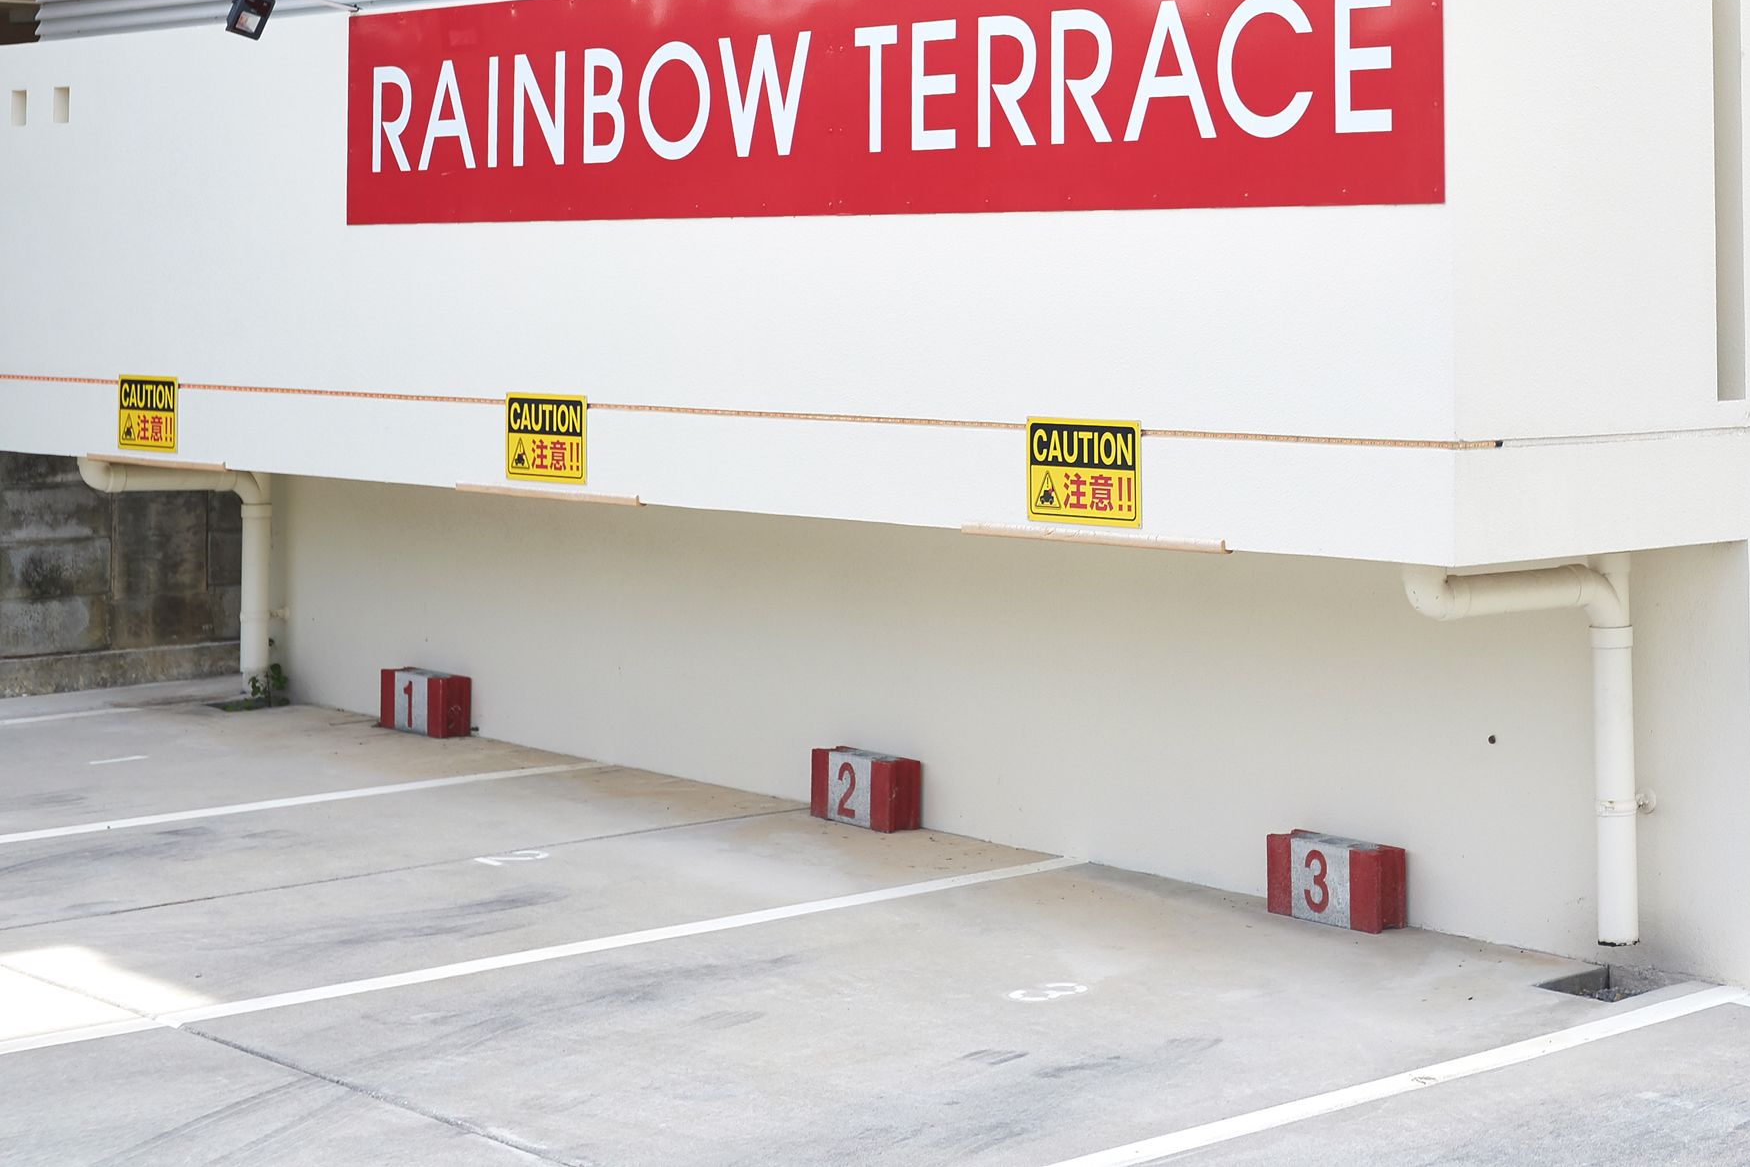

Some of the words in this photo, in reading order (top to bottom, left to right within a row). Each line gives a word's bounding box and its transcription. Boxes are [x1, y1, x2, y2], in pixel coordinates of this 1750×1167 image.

[371, 30, 812, 174] RAINBOW
[121, 382, 174, 409] CAUTION
[136, 414, 173, 443] 注意!!
[509, 401, 581, 434] CAUTION
[531, 438, 580, 472] 注意!!
[1032, 428, 1133, 466] CAUTION
[1063, 472, 1133, 513] 注意!!
[403, 680, 413, 729] 1
[837, 761, 856, 819] 2
[1303, 849, 1330, 914] 3
